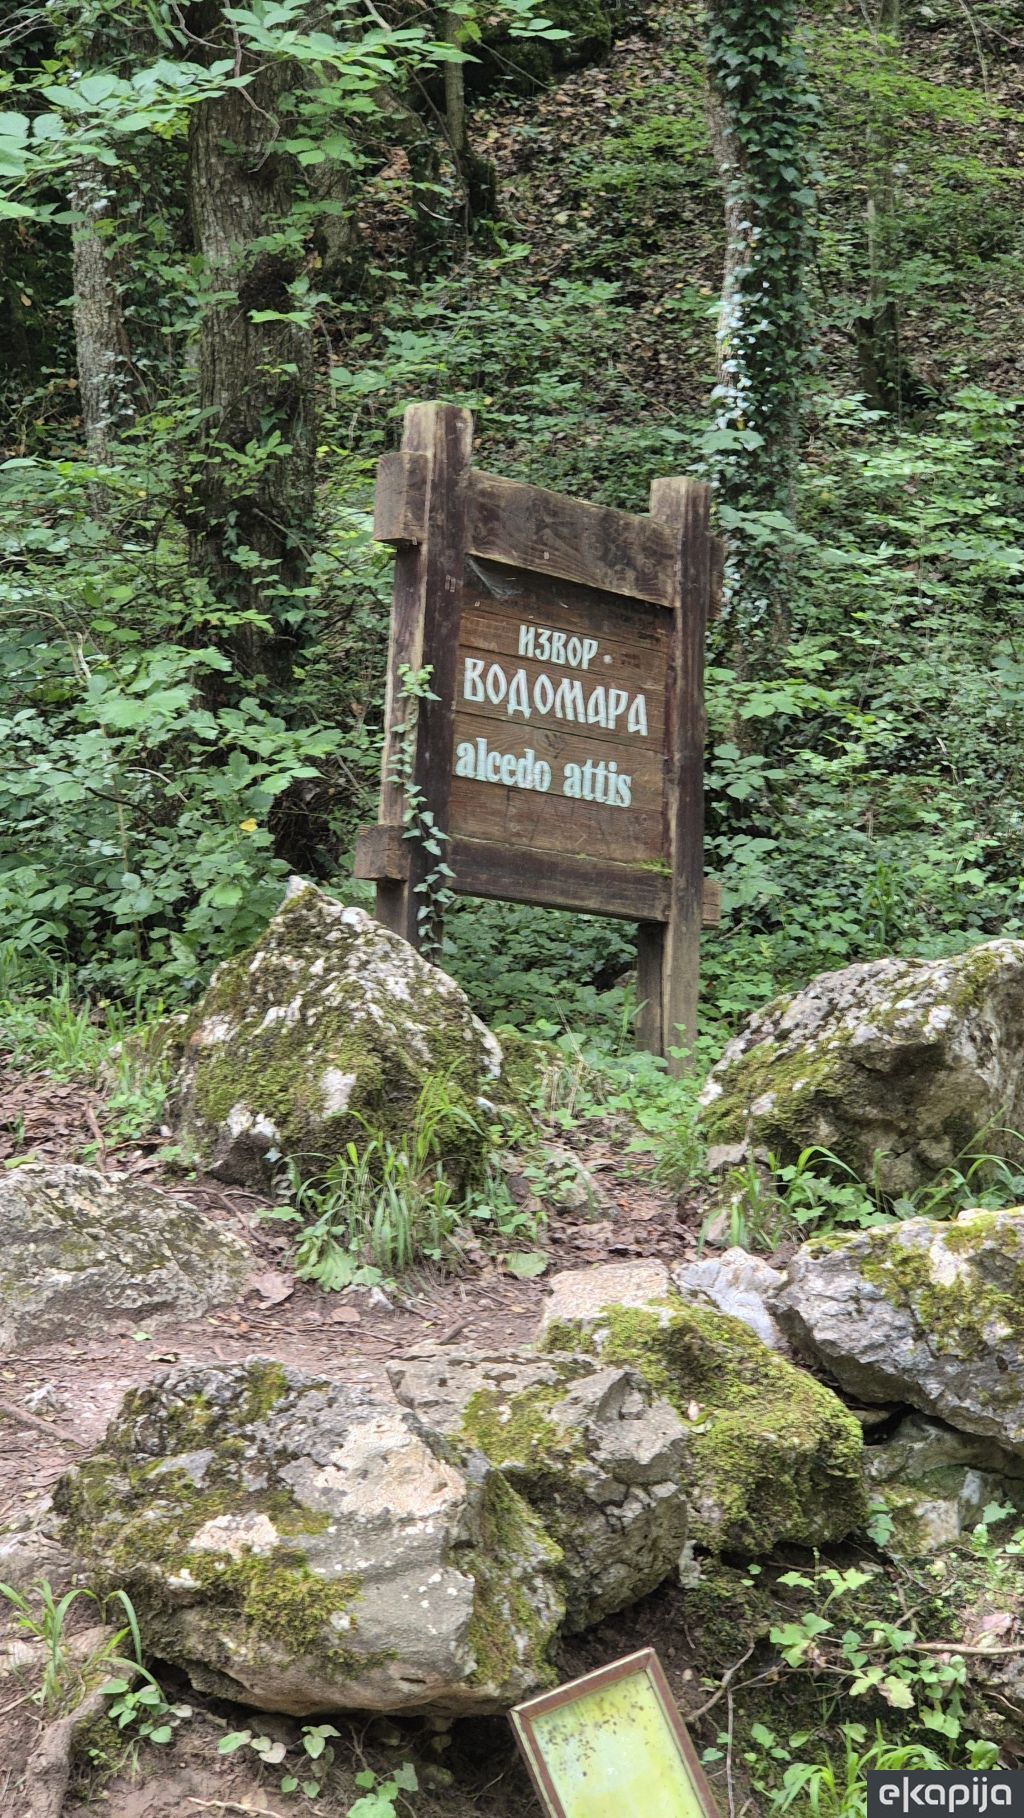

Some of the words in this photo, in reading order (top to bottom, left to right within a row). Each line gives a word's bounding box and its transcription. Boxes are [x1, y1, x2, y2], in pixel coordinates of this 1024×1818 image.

[518, 624, 599, 670] ИЗВОР
[463, 657, 649, 736] ВОДОМАРА
[455, 737, 552, 792] alcedo
[563, 759, 632, 808] attis
